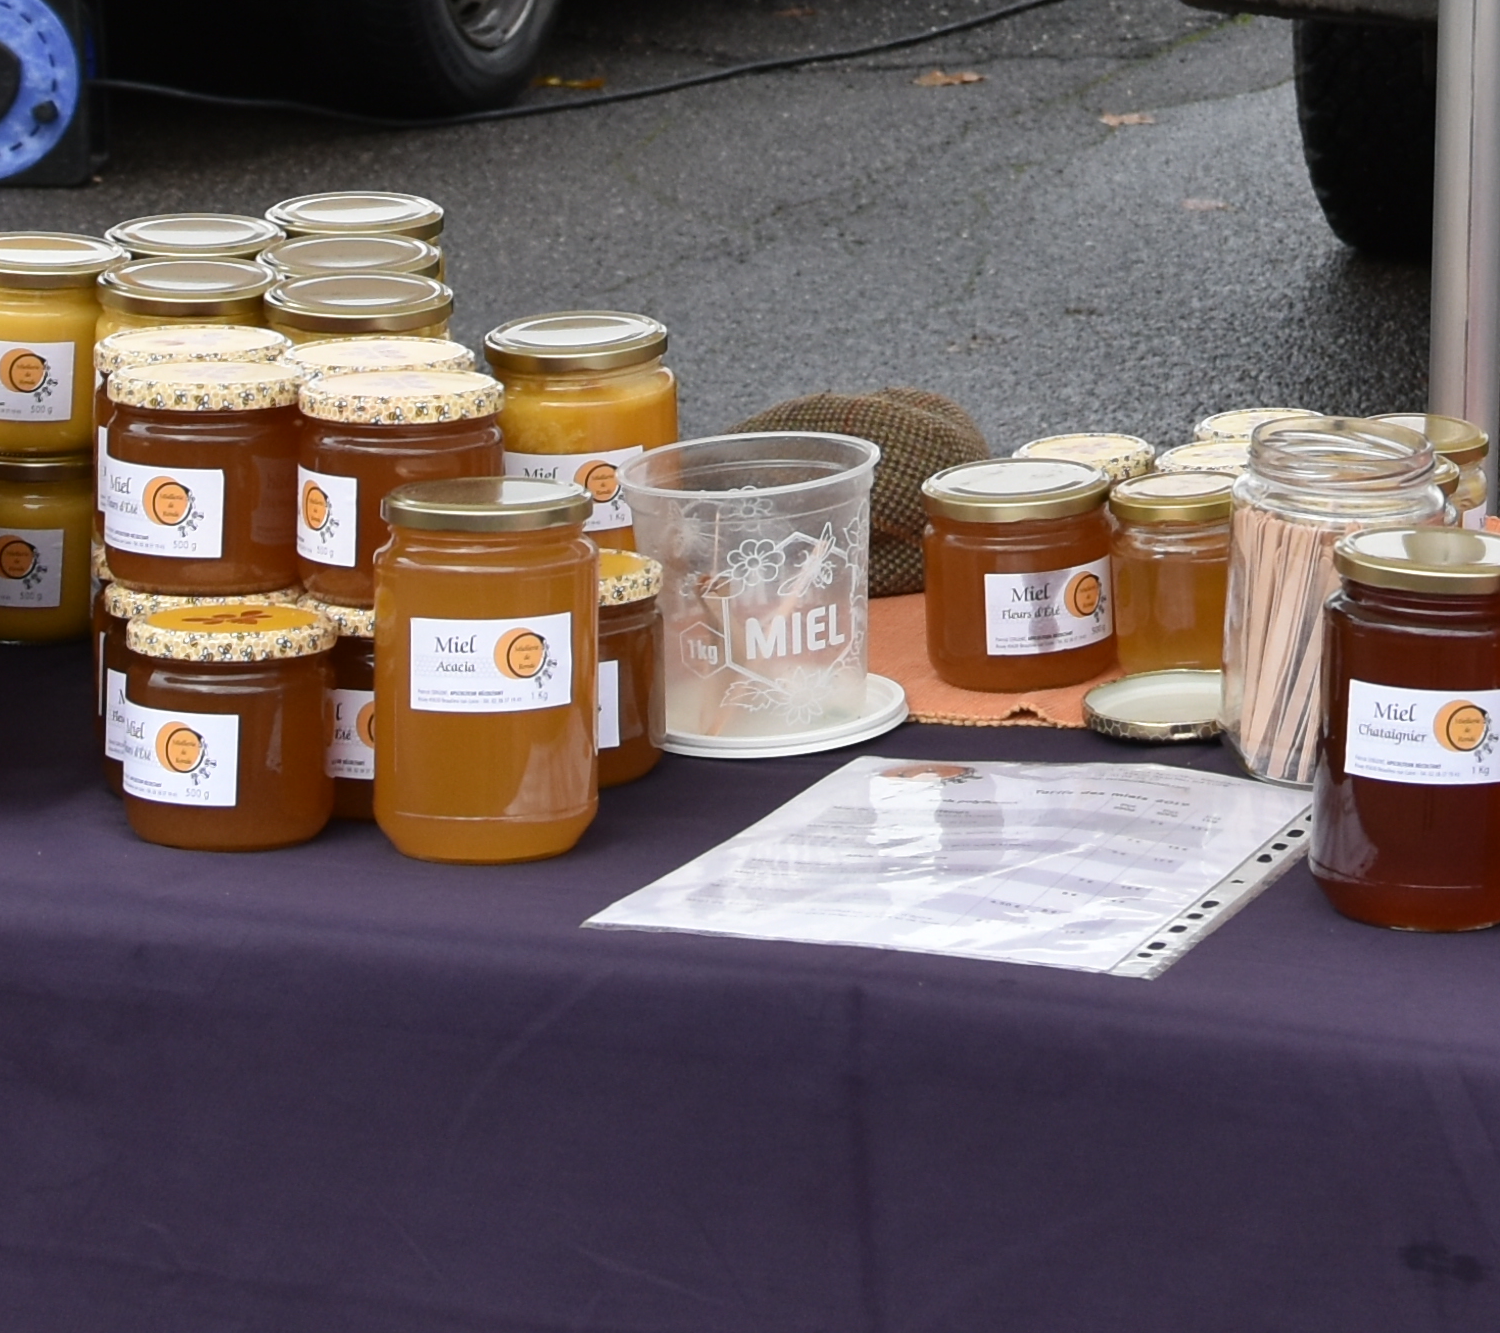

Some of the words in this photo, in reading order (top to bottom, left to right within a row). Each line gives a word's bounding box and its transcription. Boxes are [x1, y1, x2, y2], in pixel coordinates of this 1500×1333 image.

[1012, 583, 1050, 602] Miel
[1002, 608, 1031, 619] Fleurs
[746, 604, 844, 659] MIEL
[435, 635, 477, 653] Miel
[436, 662, 475, 672] Acacia
[1374, 702, 1417, 722] Miel
